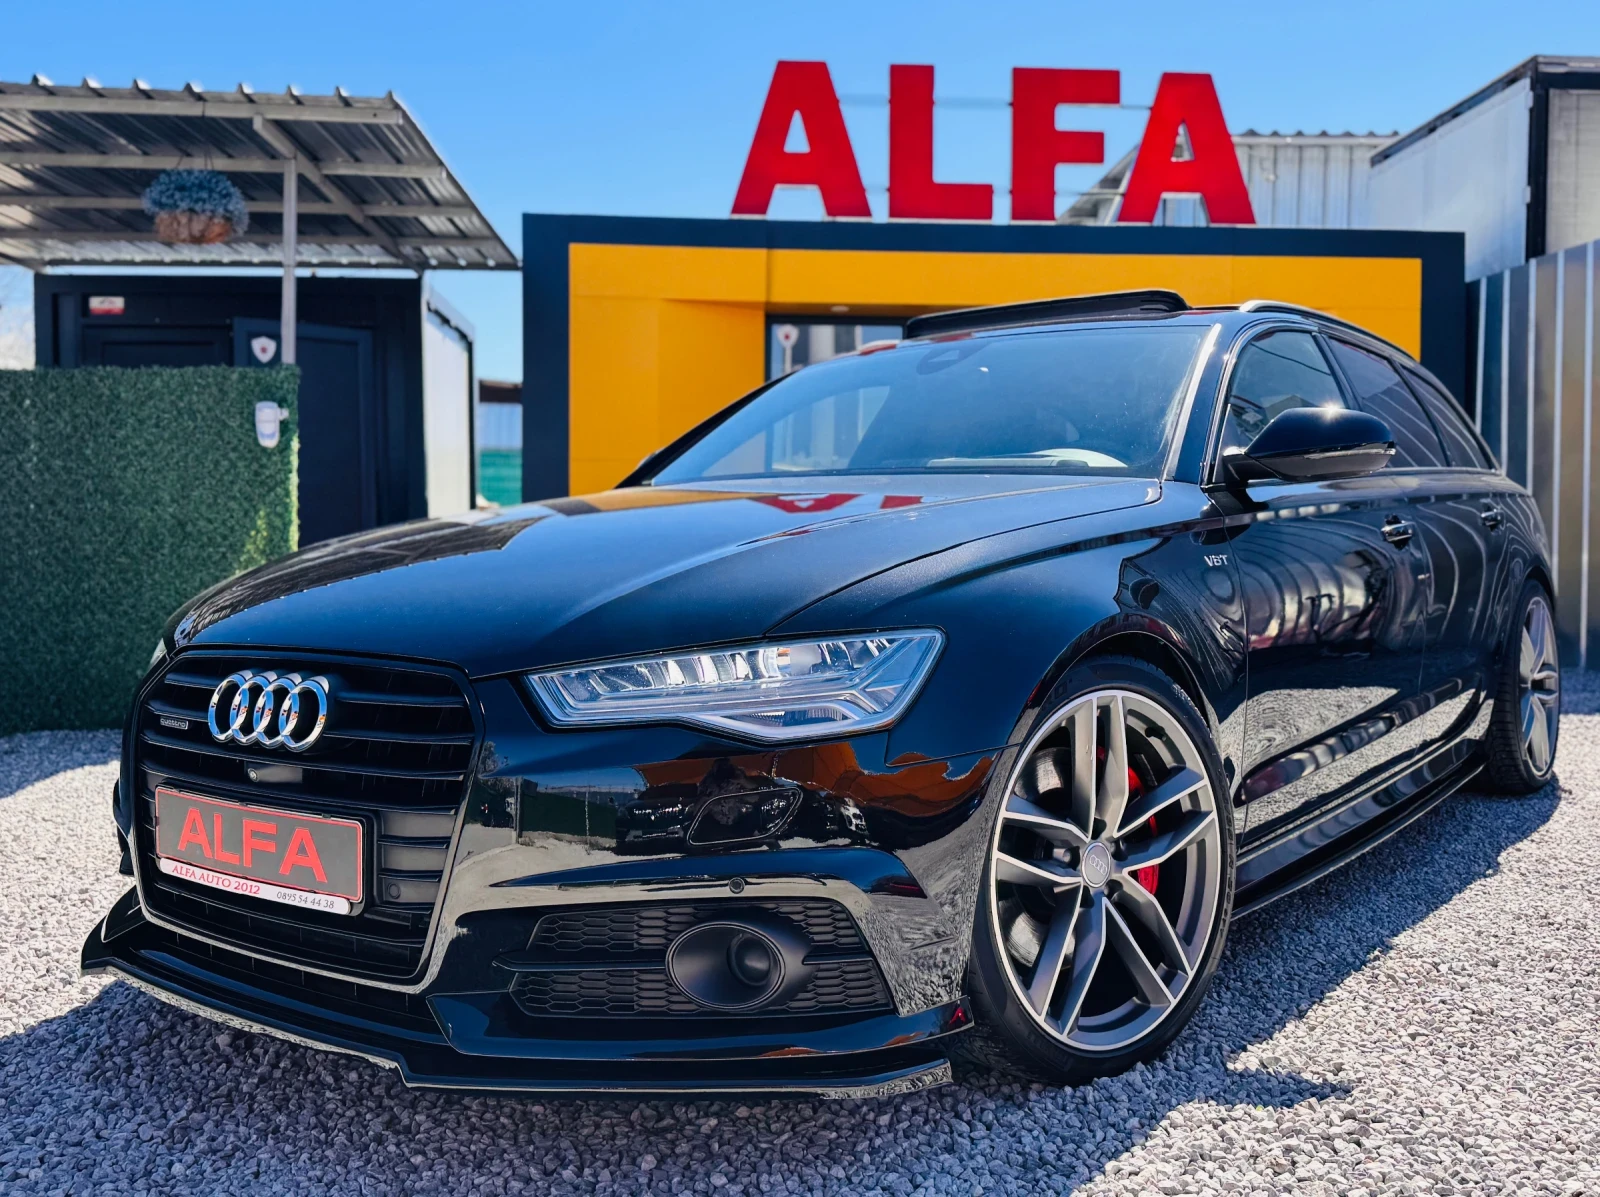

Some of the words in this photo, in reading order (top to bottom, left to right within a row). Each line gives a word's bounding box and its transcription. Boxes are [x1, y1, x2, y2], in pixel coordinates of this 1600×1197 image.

[731, 60, 1256, 226] ALFA
[160, 718, 187, 729] quattro
[178, 808, 328, 883] ALFA
[172, 864, 197, 879] ALFA
[199, 874, 232, 888] AUTO
[234, 880, 260, 895] 2012
[276, 891, 296, 902] 0895
[297, 893, 308, 905] 54
[310, 897, 323, 908] 44
[323, 899, 335, 910] 38
